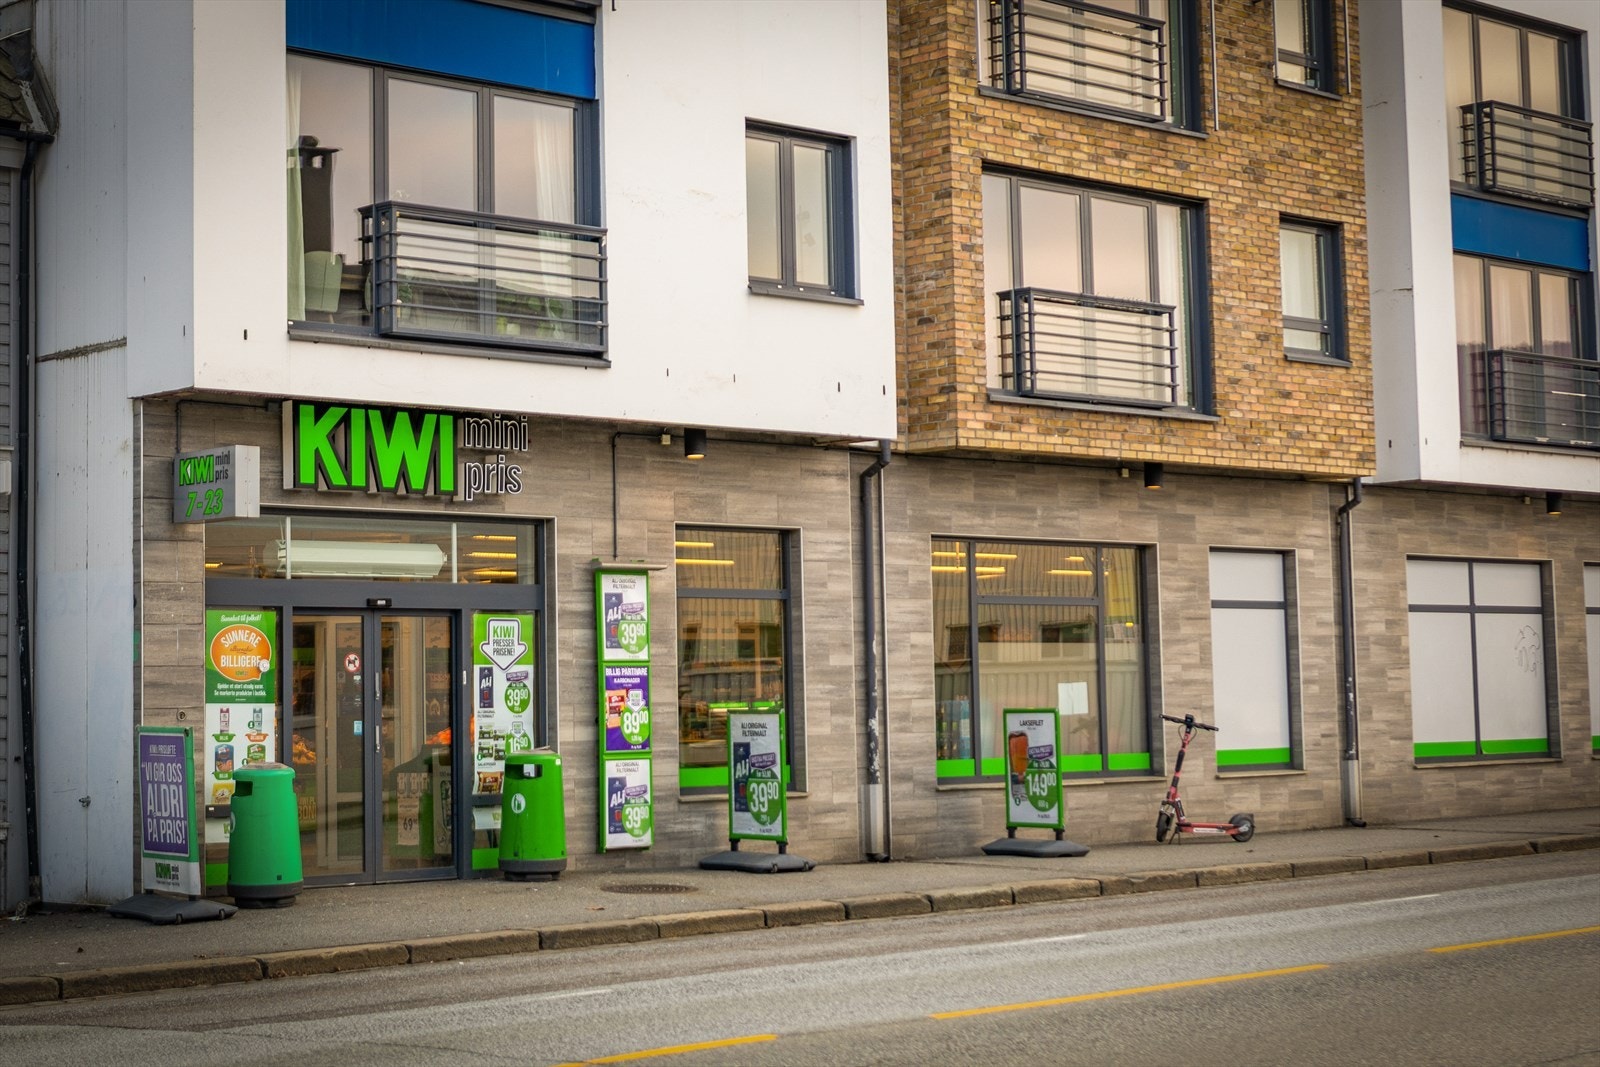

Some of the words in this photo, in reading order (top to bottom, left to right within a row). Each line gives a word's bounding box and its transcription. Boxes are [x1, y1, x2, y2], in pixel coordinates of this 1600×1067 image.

[465, 413, 529, 452] mini
[299, 404, 455, 491] KIWI
[215, 450, 231, 465] mini
[179, 455, 215, 486] KIWI
[215, 466, 229, 483] pris
[465, 454, 523, 501] pris
[220, 629, 261, 648] SUNNERE
[493, 626, 515, 638] KIWI
[492, 639, 515, 647] PRESSER
[492, 647, 515, 656] PRISENE!
[220, 655, 261, 667] BILLIGERE
[605, 667, 621, 676] BILLIG
[1019, 719, 1044, 727] LAKSEFILET
[153, 761, 165, 782] GIR
[166, 762, 183, 783] OSS
[147, 783, 185, 818] ALDRI
[147, 814, 159, 842] PÅ
[155, 862, 172, 879] KIWI
